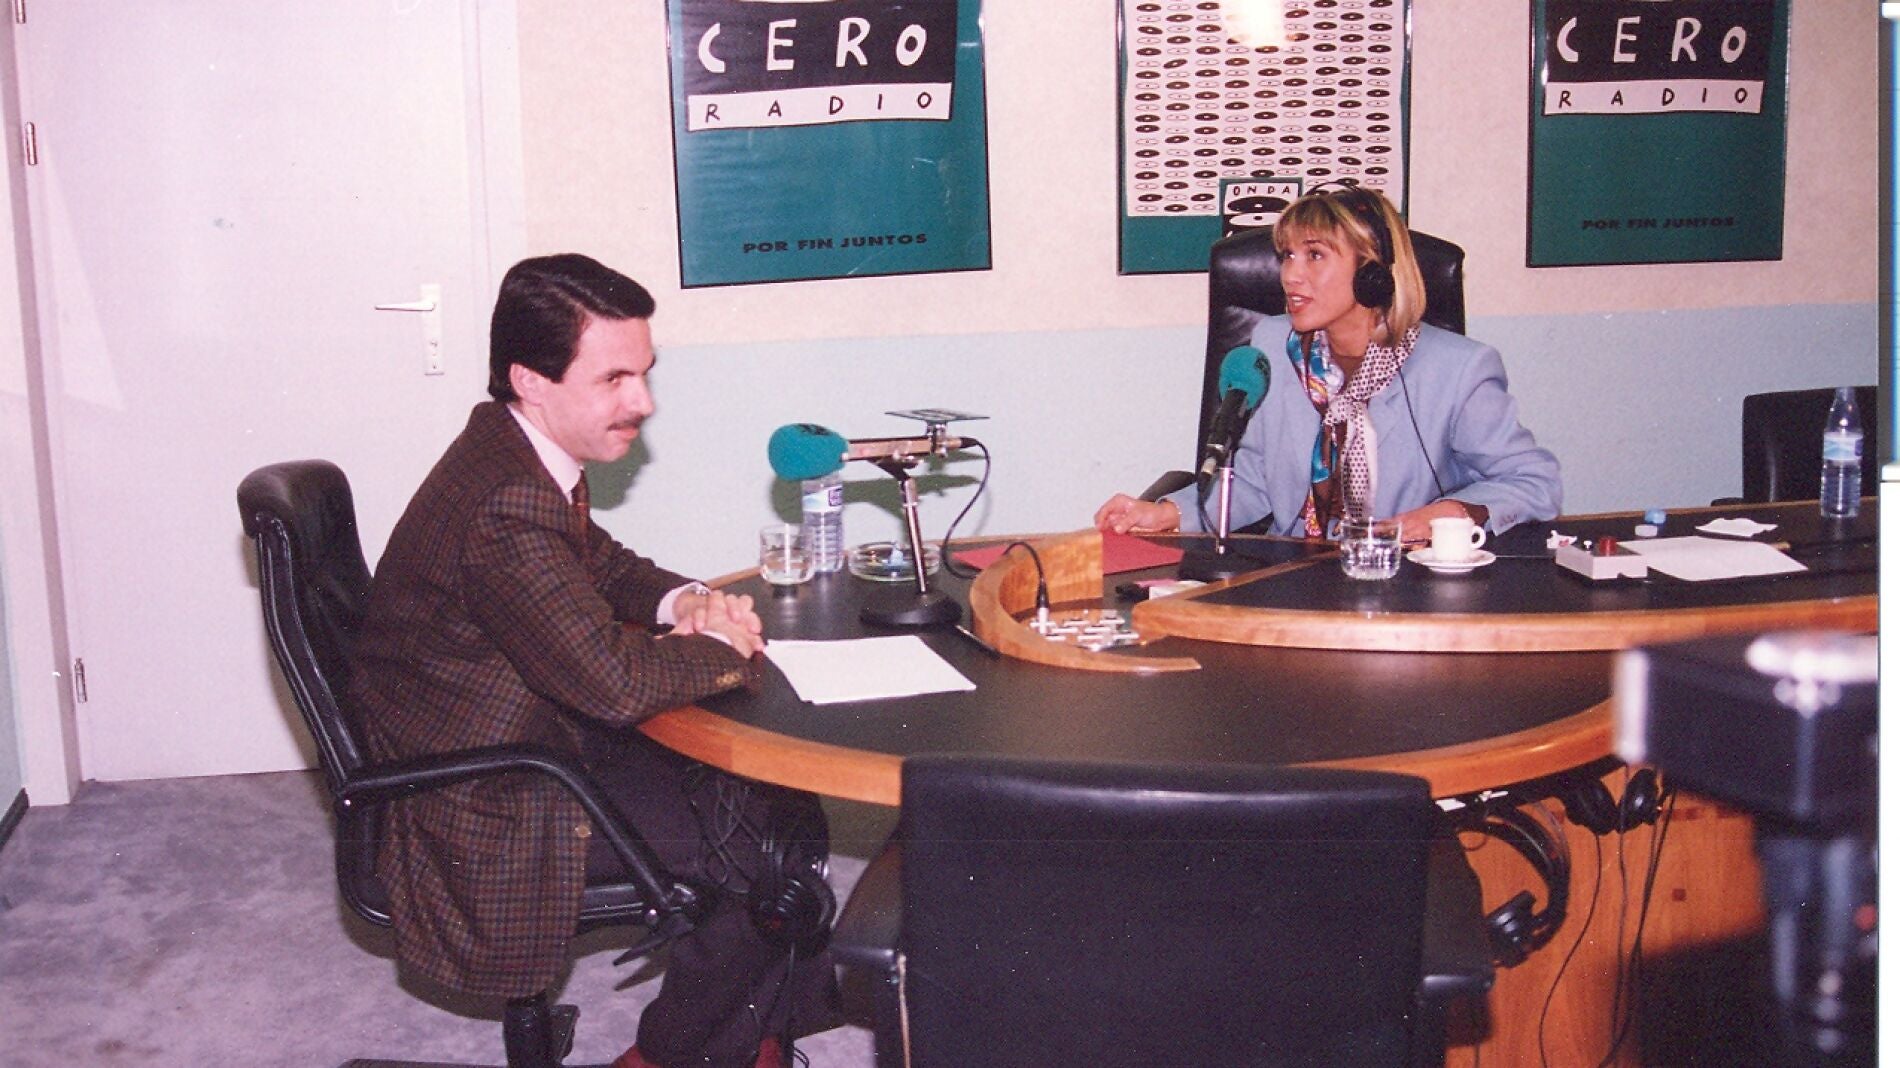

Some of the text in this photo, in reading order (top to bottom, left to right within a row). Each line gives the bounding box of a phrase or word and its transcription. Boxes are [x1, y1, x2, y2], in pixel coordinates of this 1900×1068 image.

[698, 17, 927, 74] CERO
[1556, 16, 1748, 64] CERO
[704, 92, 932, 123] RADIO
[1558, 88, 1748, 107] RADIO
[1233, 185, 1290, 196] ONDA
[1581, 215, 1736, 231] POR FIN JUNTOS
[743, 233, 928, 254] POR FIN JUNTOS
